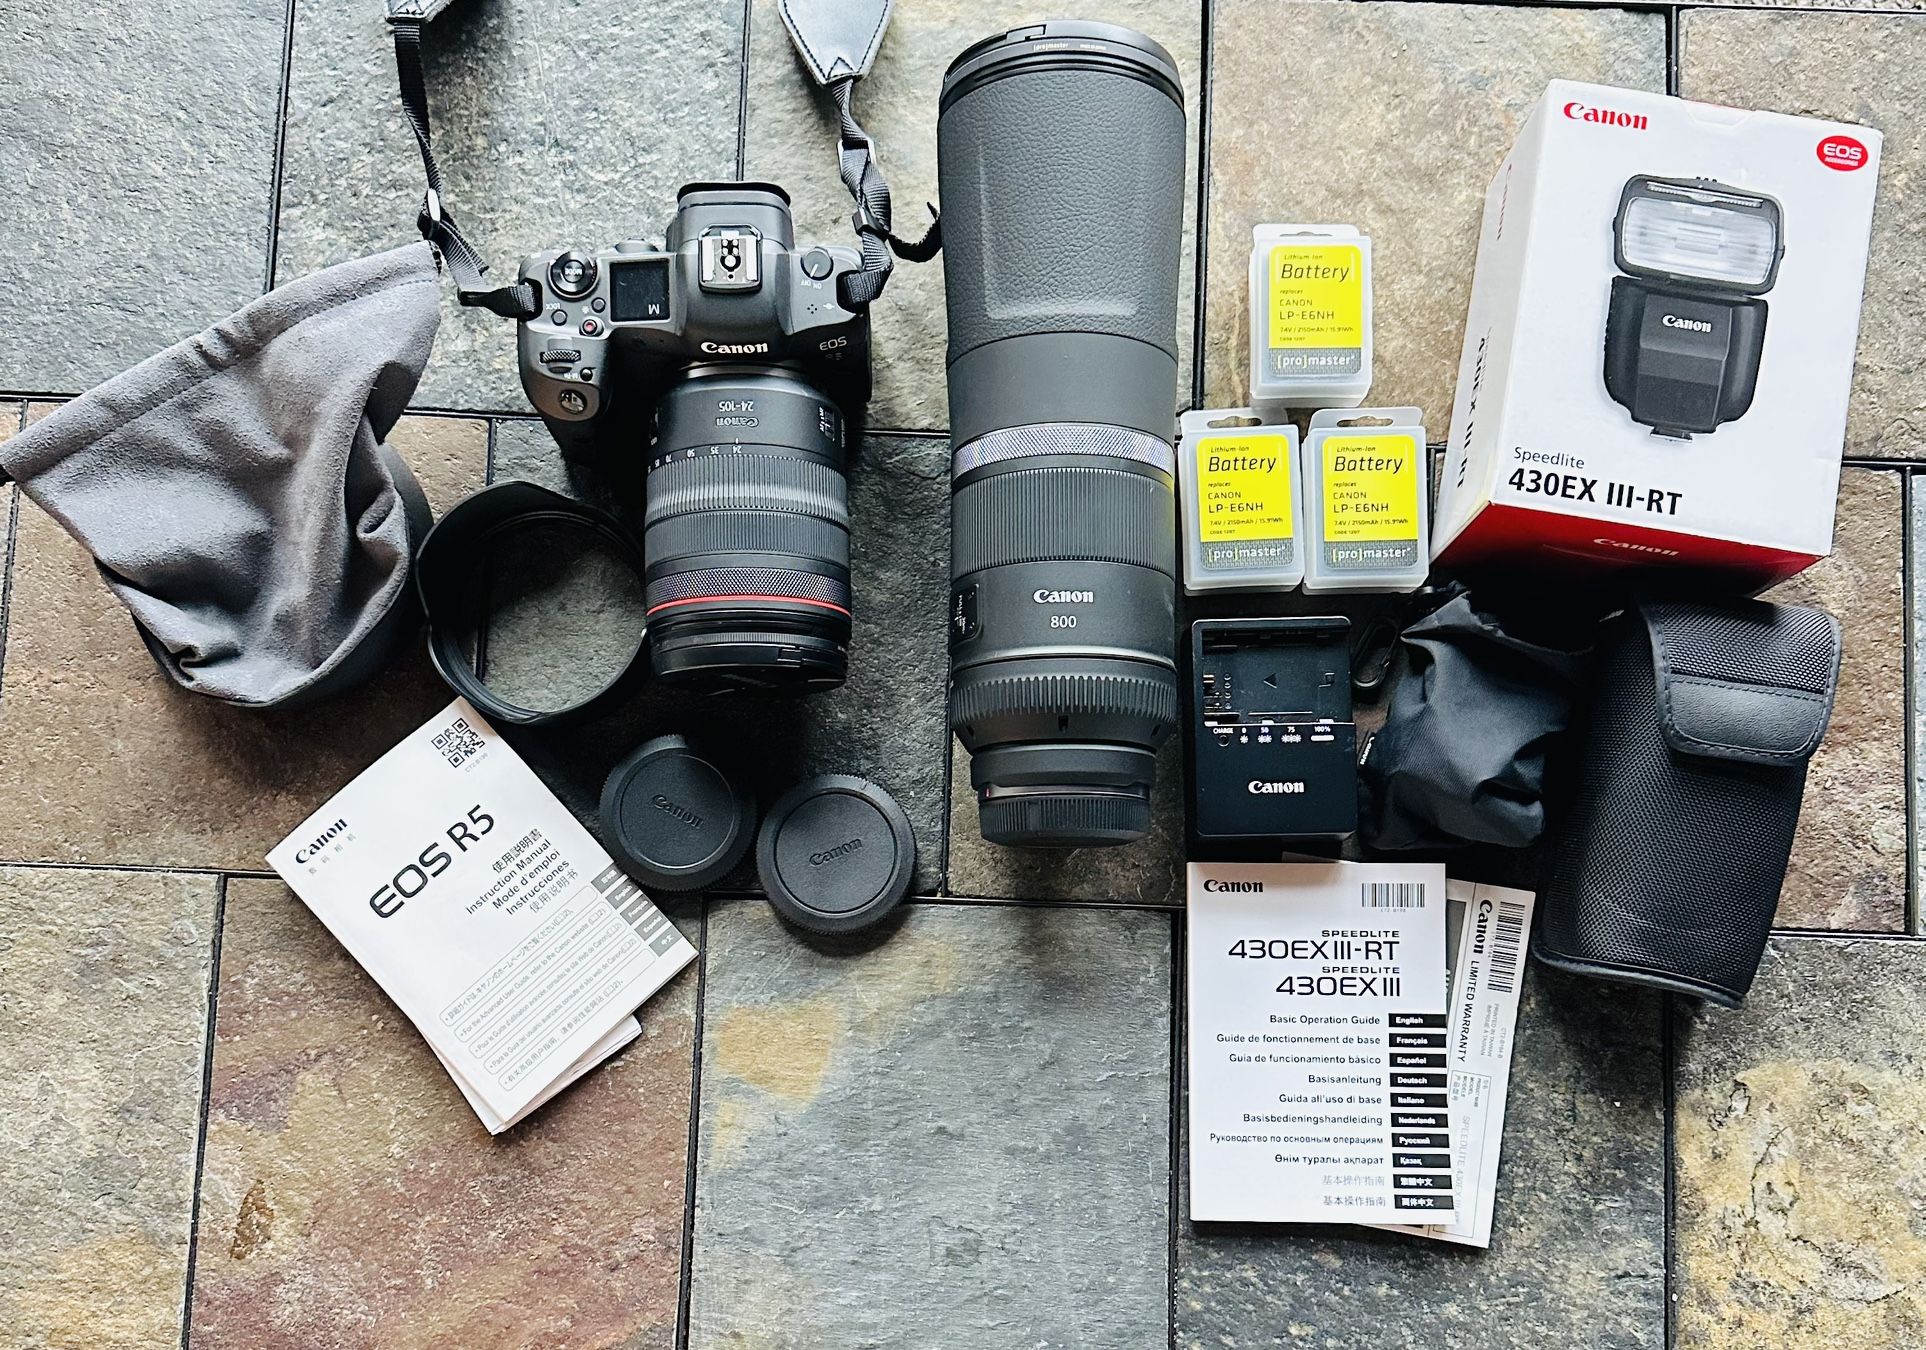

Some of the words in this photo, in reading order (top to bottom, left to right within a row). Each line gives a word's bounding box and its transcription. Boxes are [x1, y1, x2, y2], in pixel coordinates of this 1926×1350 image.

[1564, 102, 1648, 131] Canon
[1823, 143, 1862, 160] EOS
[1281, 263, 1350, 283] Battery
[648, 304, 660, 315] M
[1279, 299, 1313, 307] CANON
[1279, 311, 1335, 320] LP-E6NH
[1662, 315, 1711, 333] Canon
[700, 341, 769, 354] Canon
[819, 336, 848, 351] EOS
[718, 400, 754, 412] 24-105
[716, 416, 760, 428] Canon
[686, 449, 696, 458] 50
[710, 446, 720, 455] 35
[732, 445, 742, 454] 24
[1208, 456, 1277, 474] Battery
[1334, 456, 1404, 475] Battery
[1513, 447, 1585, 470] Speedlite
[1207, 491, 1242, 500] CANON
[1333, 491, 1367, 500] CANON
[1509, 467, 1597, 503] 430EX
[1606, 482, 1683, 516] III-RT
[1208, 502, 1264, 514] LP-E6NH
[1333, 502, 1390, 514] LP-E6NH
[1593, 538, 1679, 557] Canon
[1033, 589, 1094, 604] Canon
[1050, 615, 1077, 629] 800
[1248, 780, 1305, 794] Canon
[652, 794, 703, 830] Canon
[294, 818, 348, 864] Canon
[491, 827, 542, 874] 使用説明書
[809, 838, 864, 867] Canon
[368, 841, 452, 919] EOS
[445, 803, 494, 853] R5
[464, 869, 517, 915] Instruction
[514, 837, 551, 871] Manual
[505, 859, 570, 915] Instrucciones
[528, 867, 578, 913] 使用说明书
[1203, 879, 1264, 893] Canon
[491, 884, 520, 909] Mode
[1472, 898, 1493, 954] Canon
[1321, 930, 1400, 938] SPEEDLITE
[1228, 939, 1328, 960] 430EX
[1333, 940, 1400, 961] III-RT
[1322, 966, 1400, 974] SPEEDLITE
[1276, 976, 1378, 997] 430EX
[1465, 959, 1480, 1001] LIMITED
[1270, 1015, 1297, 1024] Basic
[1300, 1015, 1348, 1025] Operation
[1351, 1016, 1381, 1025] Guide
[1395, 1016, 1424, 1025] English
[1216, 1034, 1245, 1043] Guide
[1248, 1034, 1260, 1043] de
[1263, 1034, 1339, 1043] fonctionnement
[1342, 1035, 1354, 1044] de
[1357, 1035, 1381, 1044] base
[1457, 1002, 1473, 1062] WARRANTY
[1255, 1054, 1267, 1063] de
[1269, 1054, 1346, 1063] funcionamiento
[1308, 1074, 1382, 1086] Basisanleitung
[1279, 1094, 1308, 1103] Guida
[1311, 1094, 1344, 1103] all'uso
[1346, 1095, 1355, 1103] di
[1359, 1095, 1382, 1104] base
[1397, 1096, 1425, 1104] Italiano
[1243, 1113, 1383, 1126] Basisbedieningshandleiding
[1210, 1133, 1268, 1144] Руководство
[1270, 1135, 1281, 1143] по
[1284, 1135, 1330, 1143] основным
[1333, 1136, 1383, 1145] операциям
[1456, 1114, 1471, 1166] SPEEDLITE
[1302, 1156, 1340, 1165] туралы
[1322, 1175, 1385, 1186] 基本操作指南
[1323, 1195, 1386, 1207] 基本操作指南
